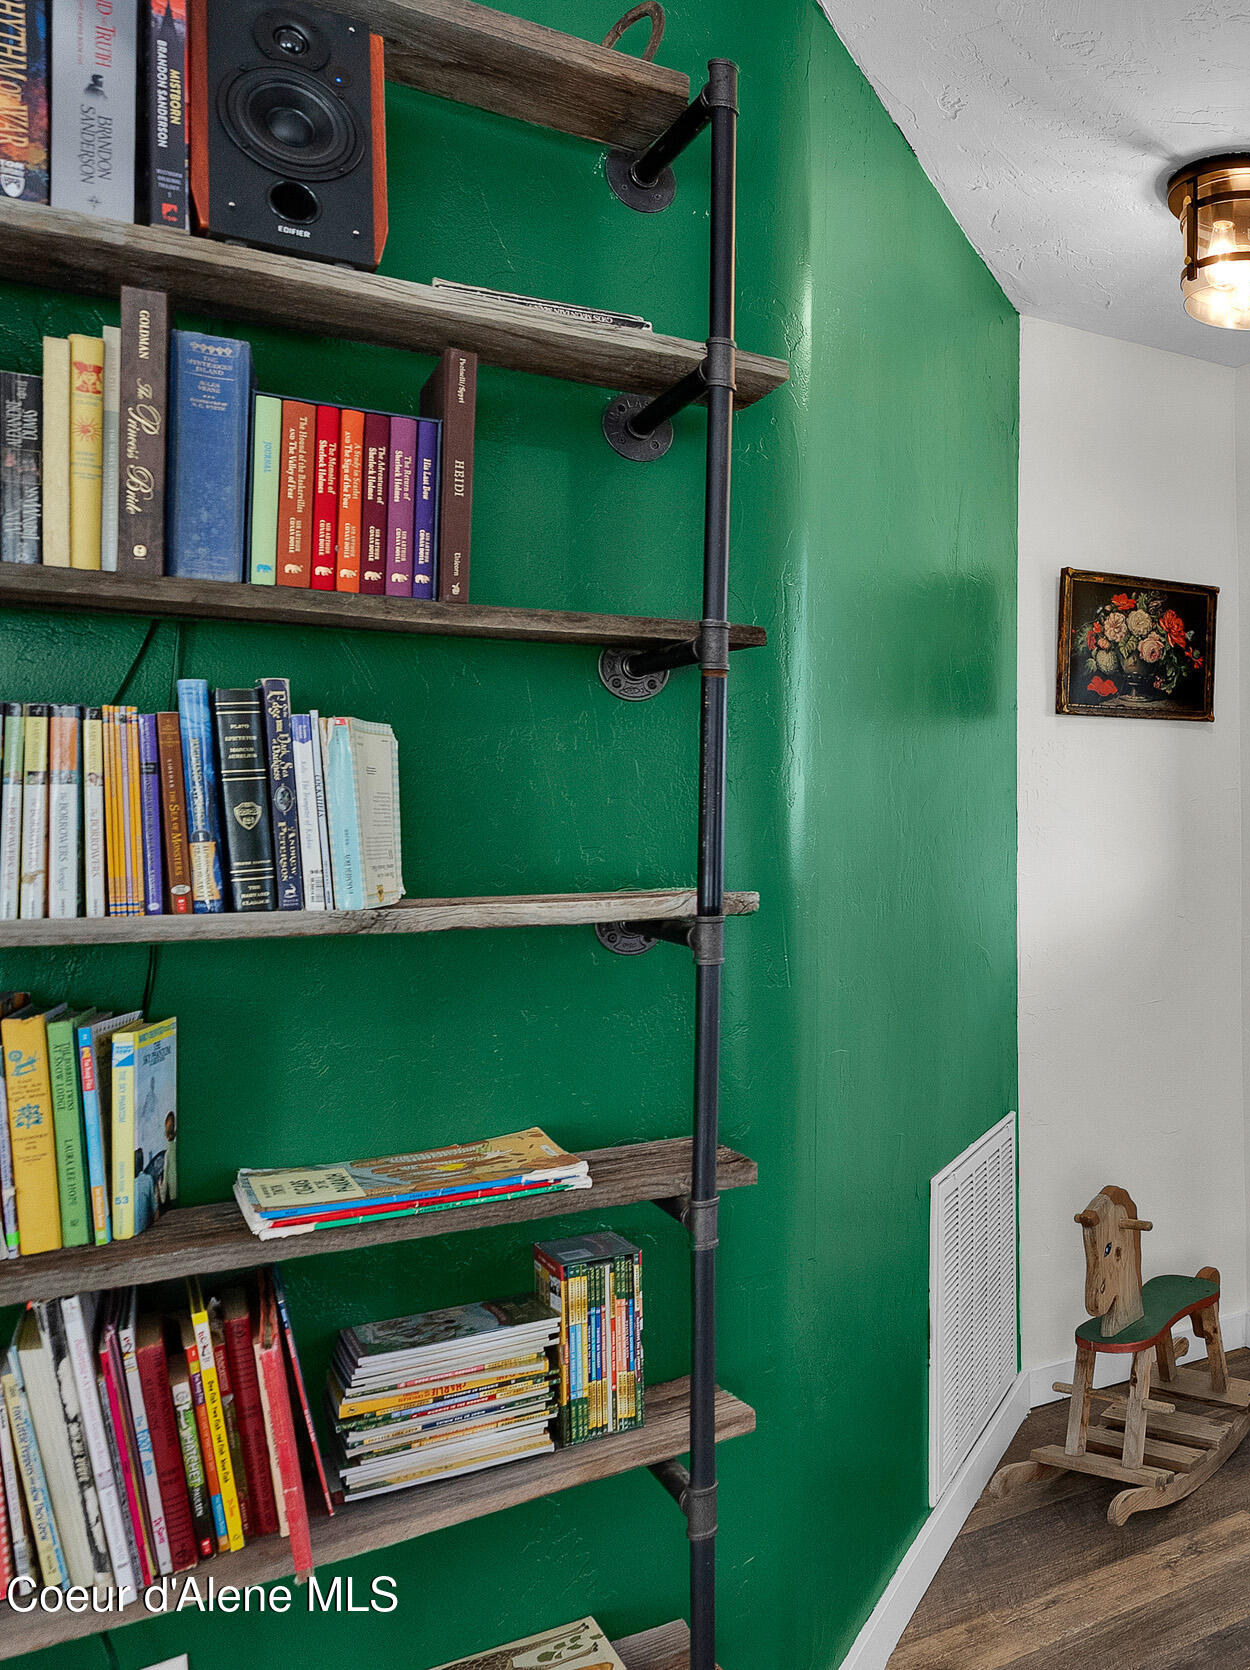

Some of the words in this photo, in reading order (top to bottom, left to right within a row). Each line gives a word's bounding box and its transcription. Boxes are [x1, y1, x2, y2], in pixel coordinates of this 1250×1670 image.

[0, 0, 26, 80] HYTHM
[94, 26, 117, 68] TRUTH
[156, 40, 169, 88] BRANDON
[168, 69, 182, 124] MISTBORN
[0, 102, 28, 147] WAR
[157, 90, 169, 147] SANDERSON
[78, 105, 97, 184] SANDERSON
[97, 116, 113, 179] BRANDON
[278, 225, 311, 238] EDIFIER
[138, 309, 150, 359] GOLDMAN
[135, 378, 150, 400] The
[6, 400, 23, 448] ALEXANDRE
[22, 410, 38, 440] DUMAS
[128, 404, 161, 460] Princess
[299, 417, 309, 429] The
[288, 441, 297, 454] The
[298, 431, 308, 454] Hound
[318, 440, 328, 467] Sherlock
[328, 443, 336, 455] The
[344, 444, 352, 457] The
[378, 447, 386, 460] The
[264, 441, 273, 472] JOURNAL
[286, 456, 297, 476] Valley
[298, 462, 306, 472] the
[342, 458, 352, 473] Sign
[352, 450, 360, 468] Study
[368, 447, 377, 474] Sherlock
[394, 450, 403, 477] Sherlock
[404, 456, 412, 468] The
[424, 458, 432, 470] His
[288, 476, 296, 485] of
[318, 469, 327, 494] Holmes
[328, 457, 336, 485] Memoirs
[344, 474, 352, 482] of
[376, 460, 386, 496] Adventures
[404, 470, 412, 492] Return
[422, 471, 432, 485] Last
[454, 460, 465, 497] HEIDI
[126, 464, 155, 515] Bride
[287, 485, 296, 500] Fear
[296, 474, 307, 513] Baskervilles
[327, 486, 336, 494] of
[352, 478, 360, 500] Scarlet
[368, 476, 376, 500] Holmes
[394, 478, 402, 502] Holmes
[403, 492, 411, 501] of
[422, 486, 430, 500] Bow
[342, 494, 350, 509] Four
[376, 496, 384, 505] of
[452, 552, 462, 576] Unicorn
[267, 690, 288, 719] Edge
[277, 734, 292, 758] Dark
[270, 745, 282, 781] Darkness
[281, 762, 293, 778] Sea
[168, 804, 180, 822] SEA
[58, 802, 70, 863] BORROWERS
[90, 819, 100, 878] BORROWERS
[170, 833, 182, 876] MONSTERS
[278, 822, 289, 882] PETERSON
[288, 833, 298, 874] ANDREW
[54, 1056, 64, 1080] SNOW
[56, 1083, 66, 1112] LODGE
[64, 1138, 74, 1165] LAURA
[66, 1166, 76, 1180] LEE
[115, 1196, 130, 1206] 53
[208, 1380, 216, 1390] One
[432, 1383, 466, 1396] CHARLIE
[210, 1392, 218, 1404] fish
[210, 1406, 219, 1417] two
[213, 1418, 222, 1430] fish
[214, 1434, 222, 1442] red
[217, 1444, 225, 1454] fish
[183, 1436, 203, 1485] HATCHET
[219, 1460, 228, 1470] blue
[222, 1470, 230, 1483] fish
[192, 1488, 204, 1517] PAULSEN
[156, 1527, 165, 1544] Seuss
